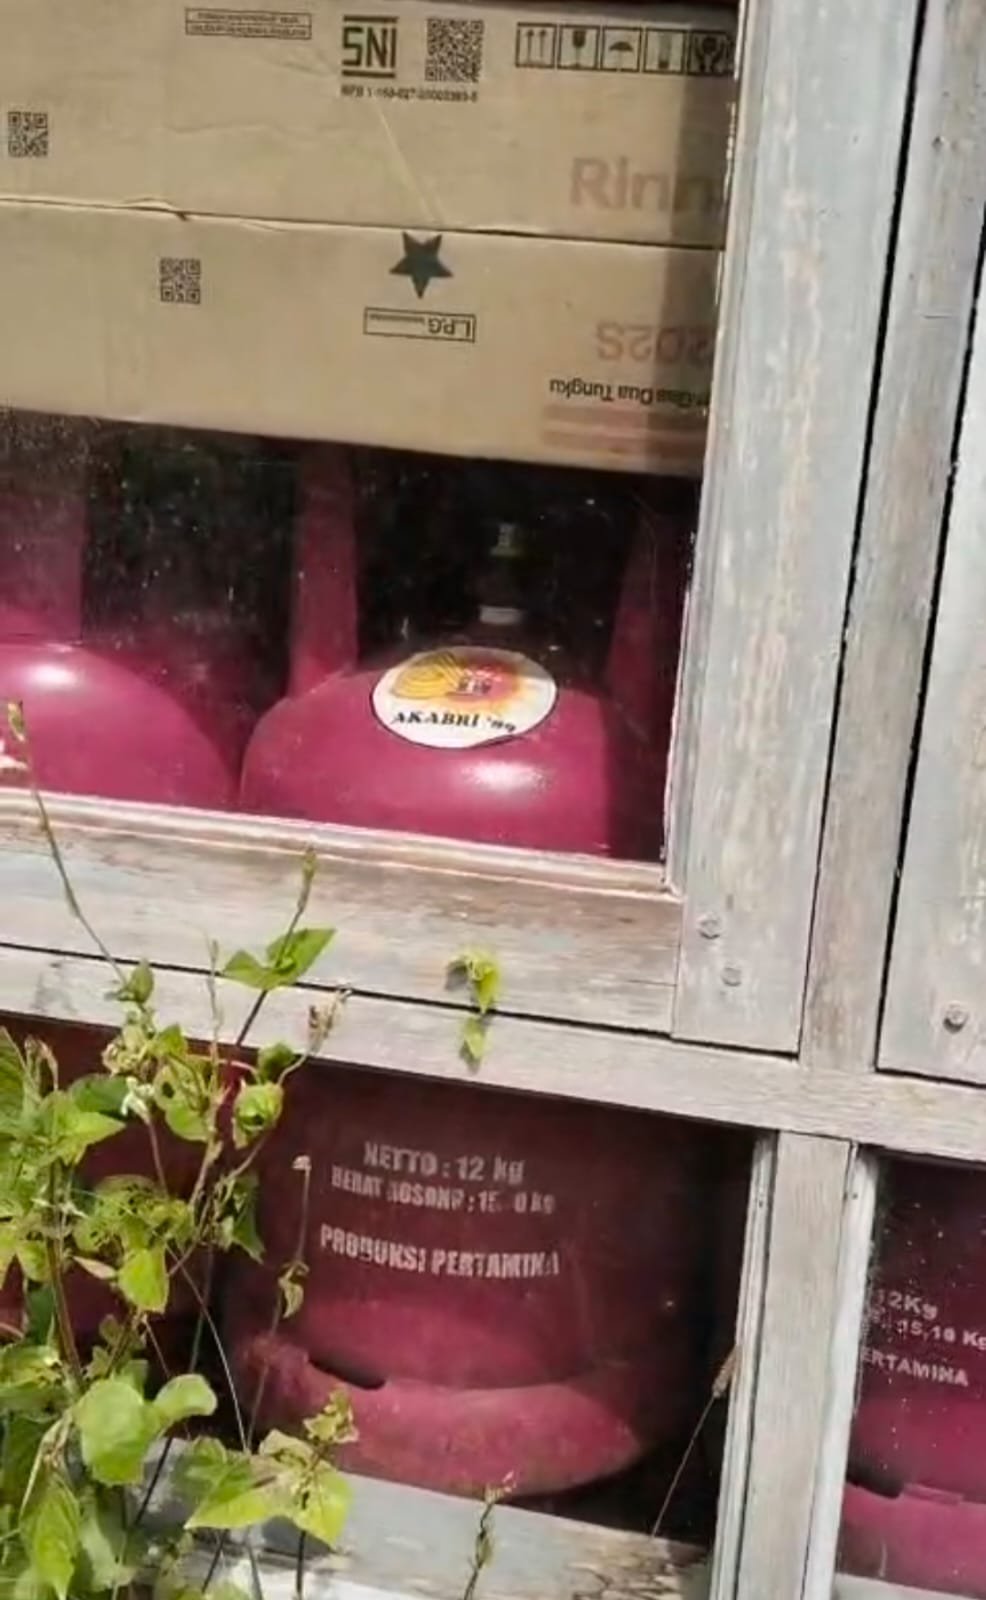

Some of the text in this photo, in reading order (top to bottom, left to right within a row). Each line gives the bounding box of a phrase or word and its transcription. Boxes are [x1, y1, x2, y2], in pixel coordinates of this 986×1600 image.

[343, 27, 396, 67] SNI
[549, 377, 615, 402] Tungku
[618, 383, 653, 405] Dua
[391, 711, 480, 728] AKABRI
[364, 1142, 438, 1176] NETTO
[457, 1156, 486, 1182] 12
[493, 1156, 526, 1185] kg
[331, 1166, 382, 1197] BERAT
[320, 1223, 427, 1273] PRODUKSI
